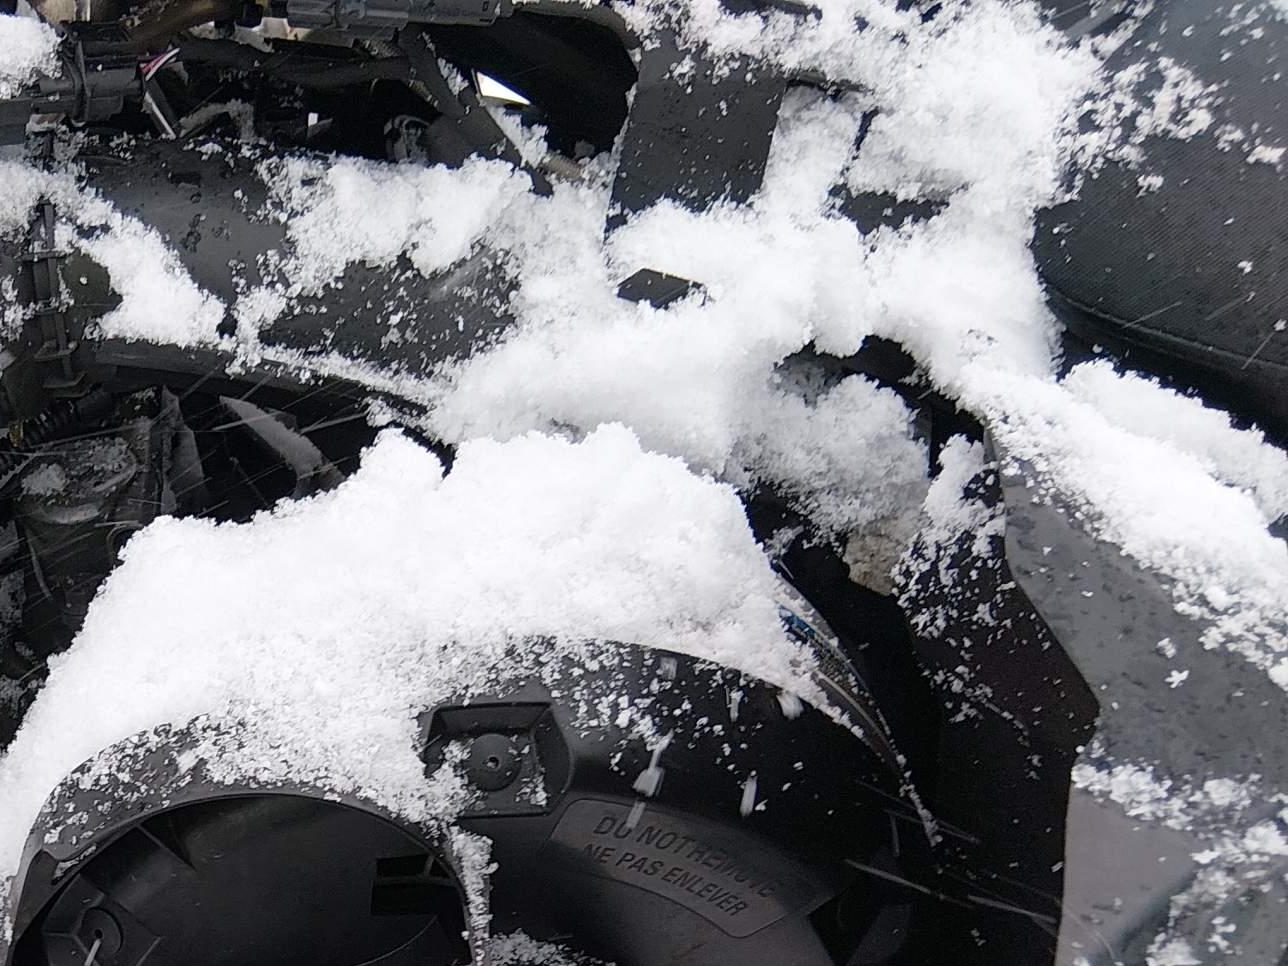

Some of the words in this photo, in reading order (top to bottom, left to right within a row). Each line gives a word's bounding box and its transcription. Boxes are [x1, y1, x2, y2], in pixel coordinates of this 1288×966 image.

[636, 825, 695, 854] NOT
[583, 843, 614, 864] NE
[615, 852, 664, 876] PAS
[661, 867, 750, 916] ENLEVER
